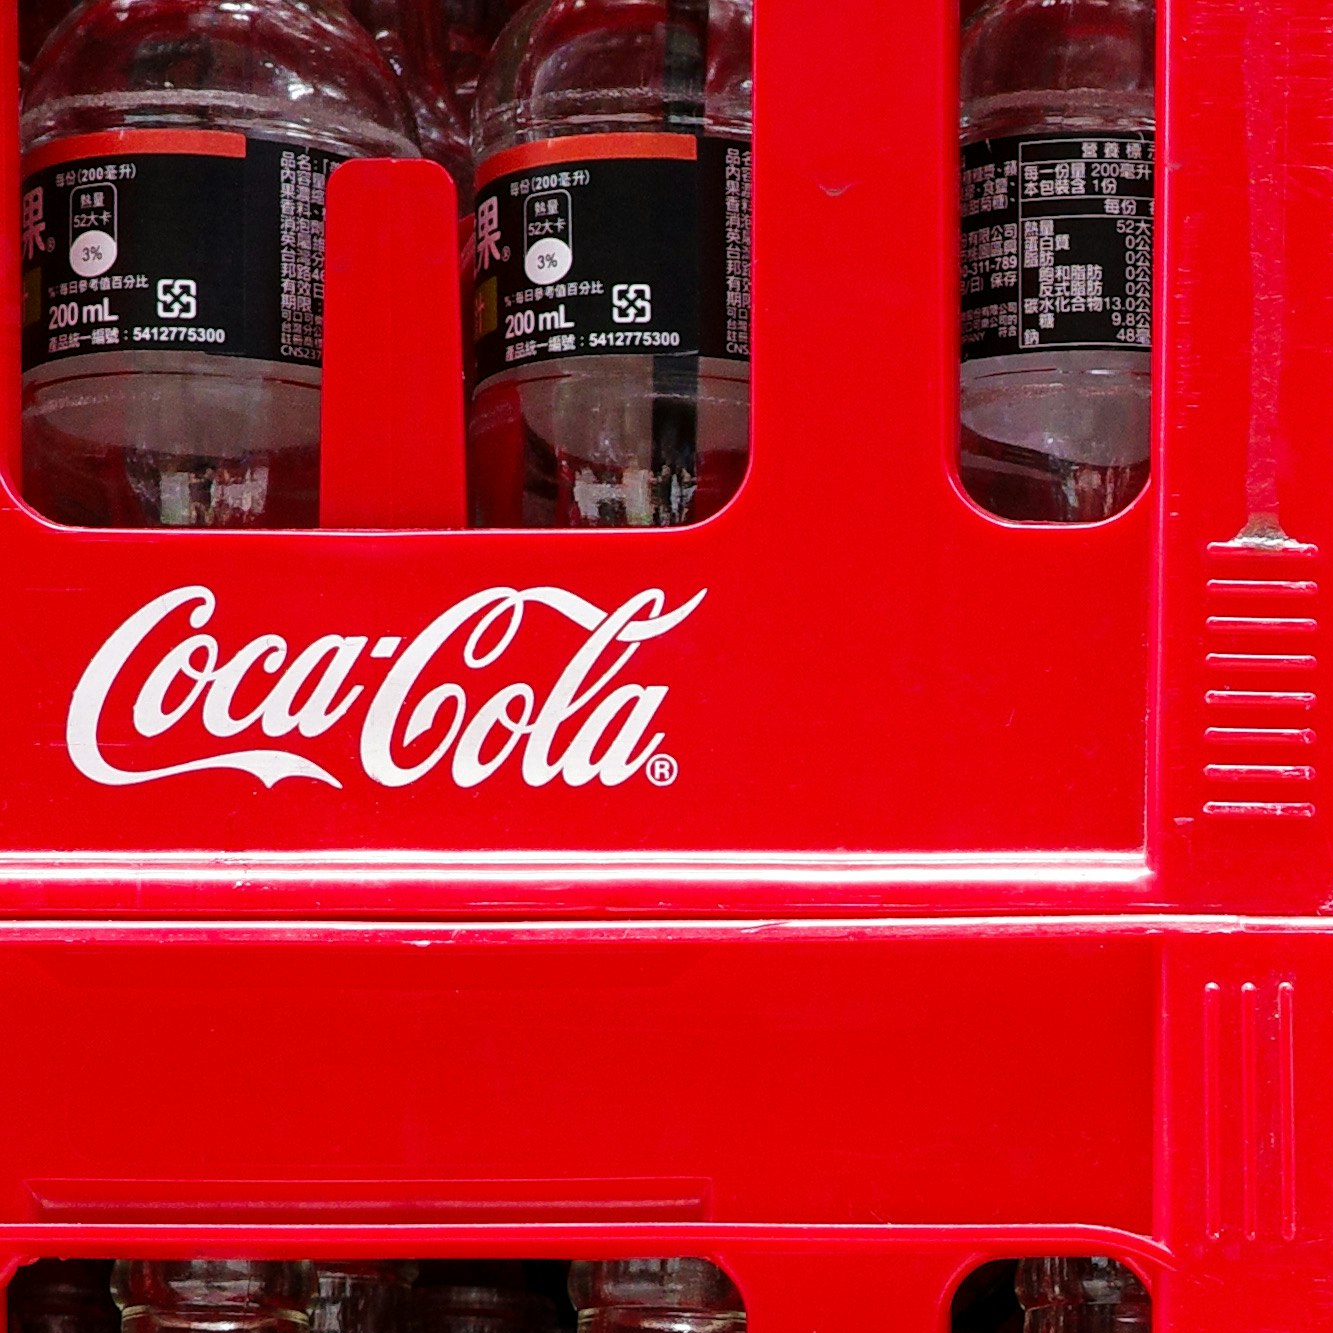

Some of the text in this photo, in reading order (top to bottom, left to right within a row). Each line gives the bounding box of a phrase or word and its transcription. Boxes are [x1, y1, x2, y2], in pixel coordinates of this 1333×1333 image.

[1091, 163, 1152, 180] 200毫升
[80, 192, 105, 208] 熱量
[534, 199, 559, 217] 熱量
[73, 210, 113, 228] 52大卡
[528, 217, 566, 236] 52大卡
[82, 245, 103, 261] 3%
[537, 252, 558, 270] 3%
[49, 297, 118, 330] 200 mL
[505, 304, 575, 339] 200 mL
[67, 586, 707, 788] Coca-Cola
